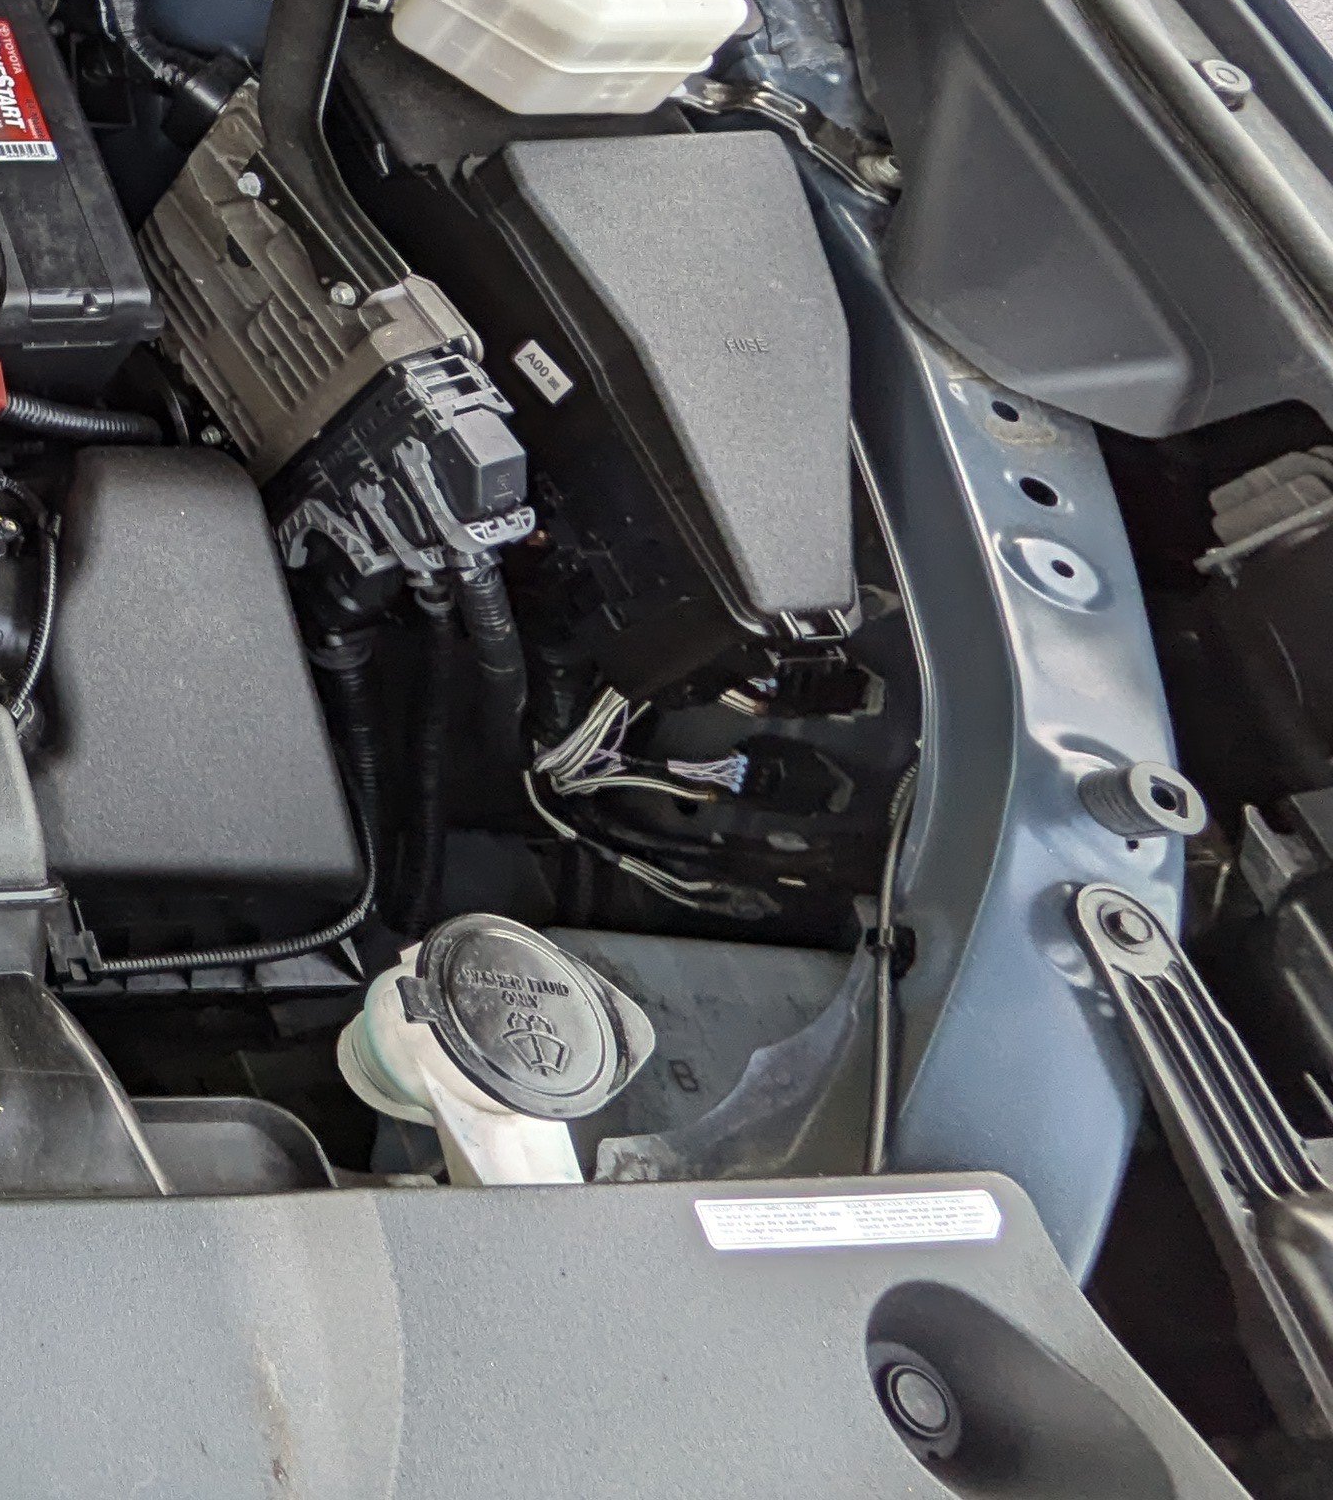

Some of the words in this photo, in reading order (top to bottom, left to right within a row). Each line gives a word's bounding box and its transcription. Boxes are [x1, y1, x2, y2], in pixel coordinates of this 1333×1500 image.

[2, 39, 23, 74] TOYOTA
[723, 338, 769, 353] FUSE
[457, 968, 523, 990] WASHER
[526, 975, 570, 997] FLUID
[501, 990, 538, 1008] ONLY
